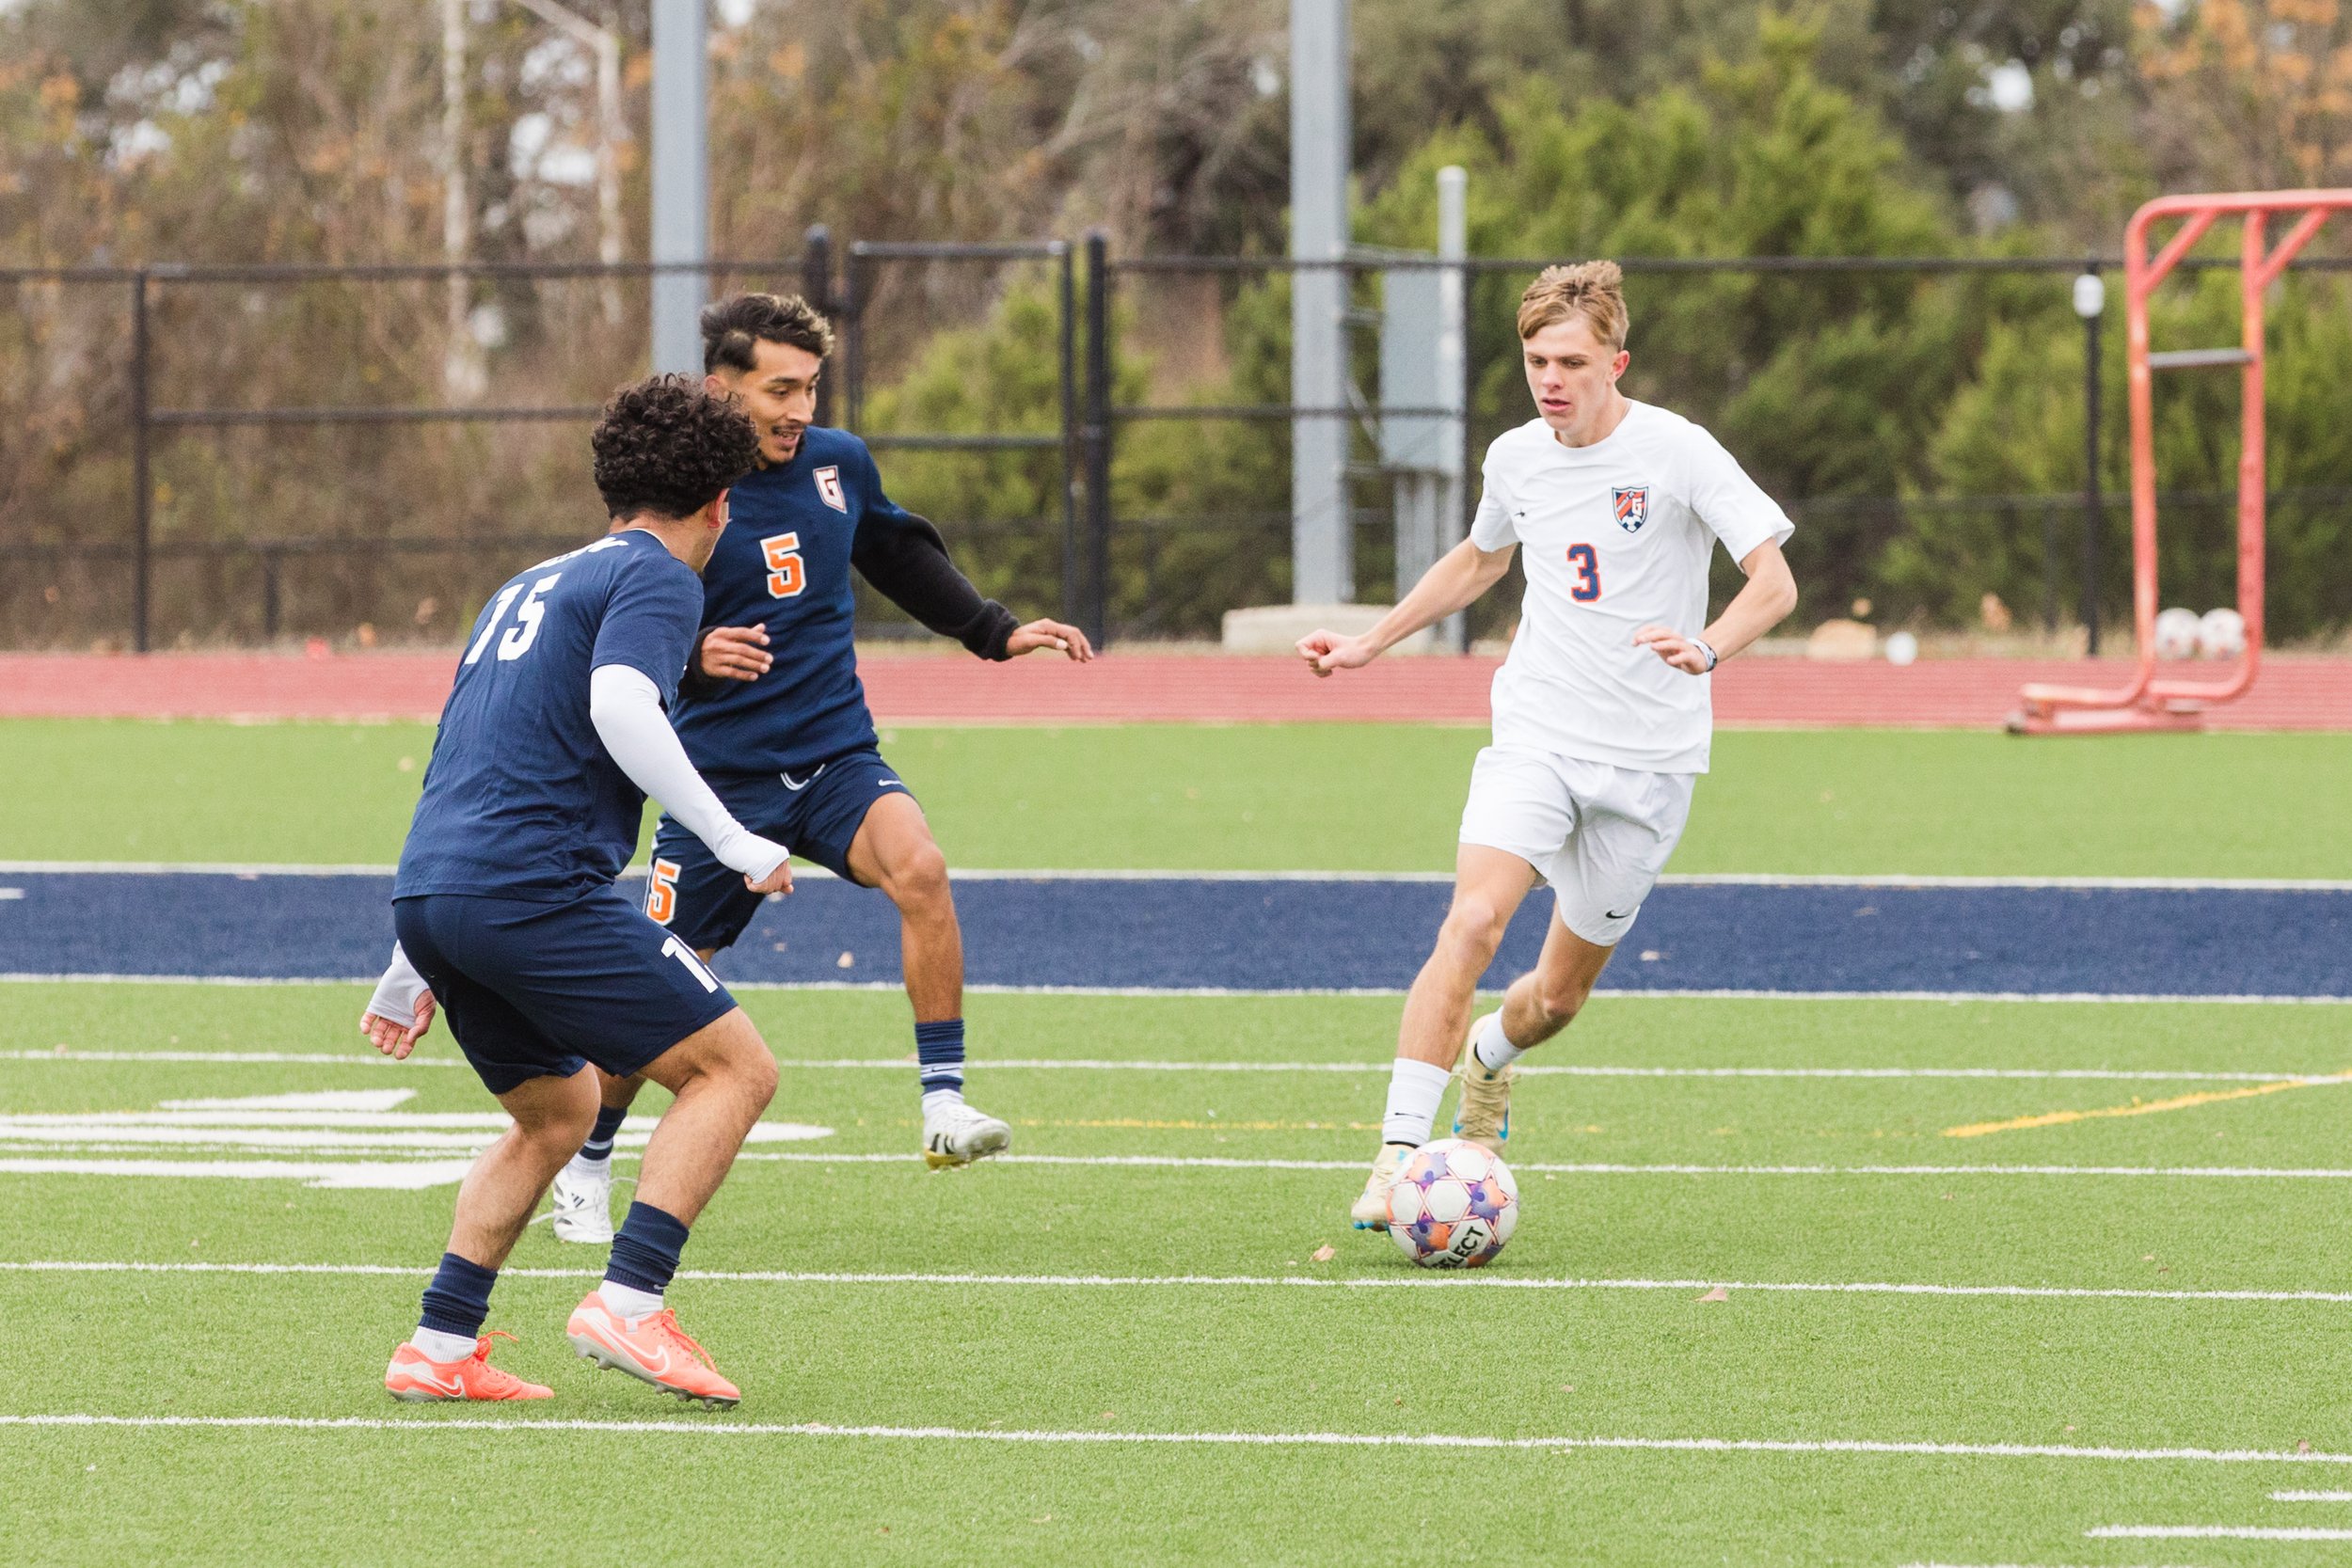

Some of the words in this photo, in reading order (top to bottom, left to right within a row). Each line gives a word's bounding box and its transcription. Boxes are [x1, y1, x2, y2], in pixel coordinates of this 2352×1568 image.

[813, 465, 847, 514] G
[760, 531, 806, 599] 5
[1566, 543, 1601, 602] 3
[464, 572, 563, 665] 15
[646, 858, 682, 926] 5
[661, 934, 722, 993] 1
